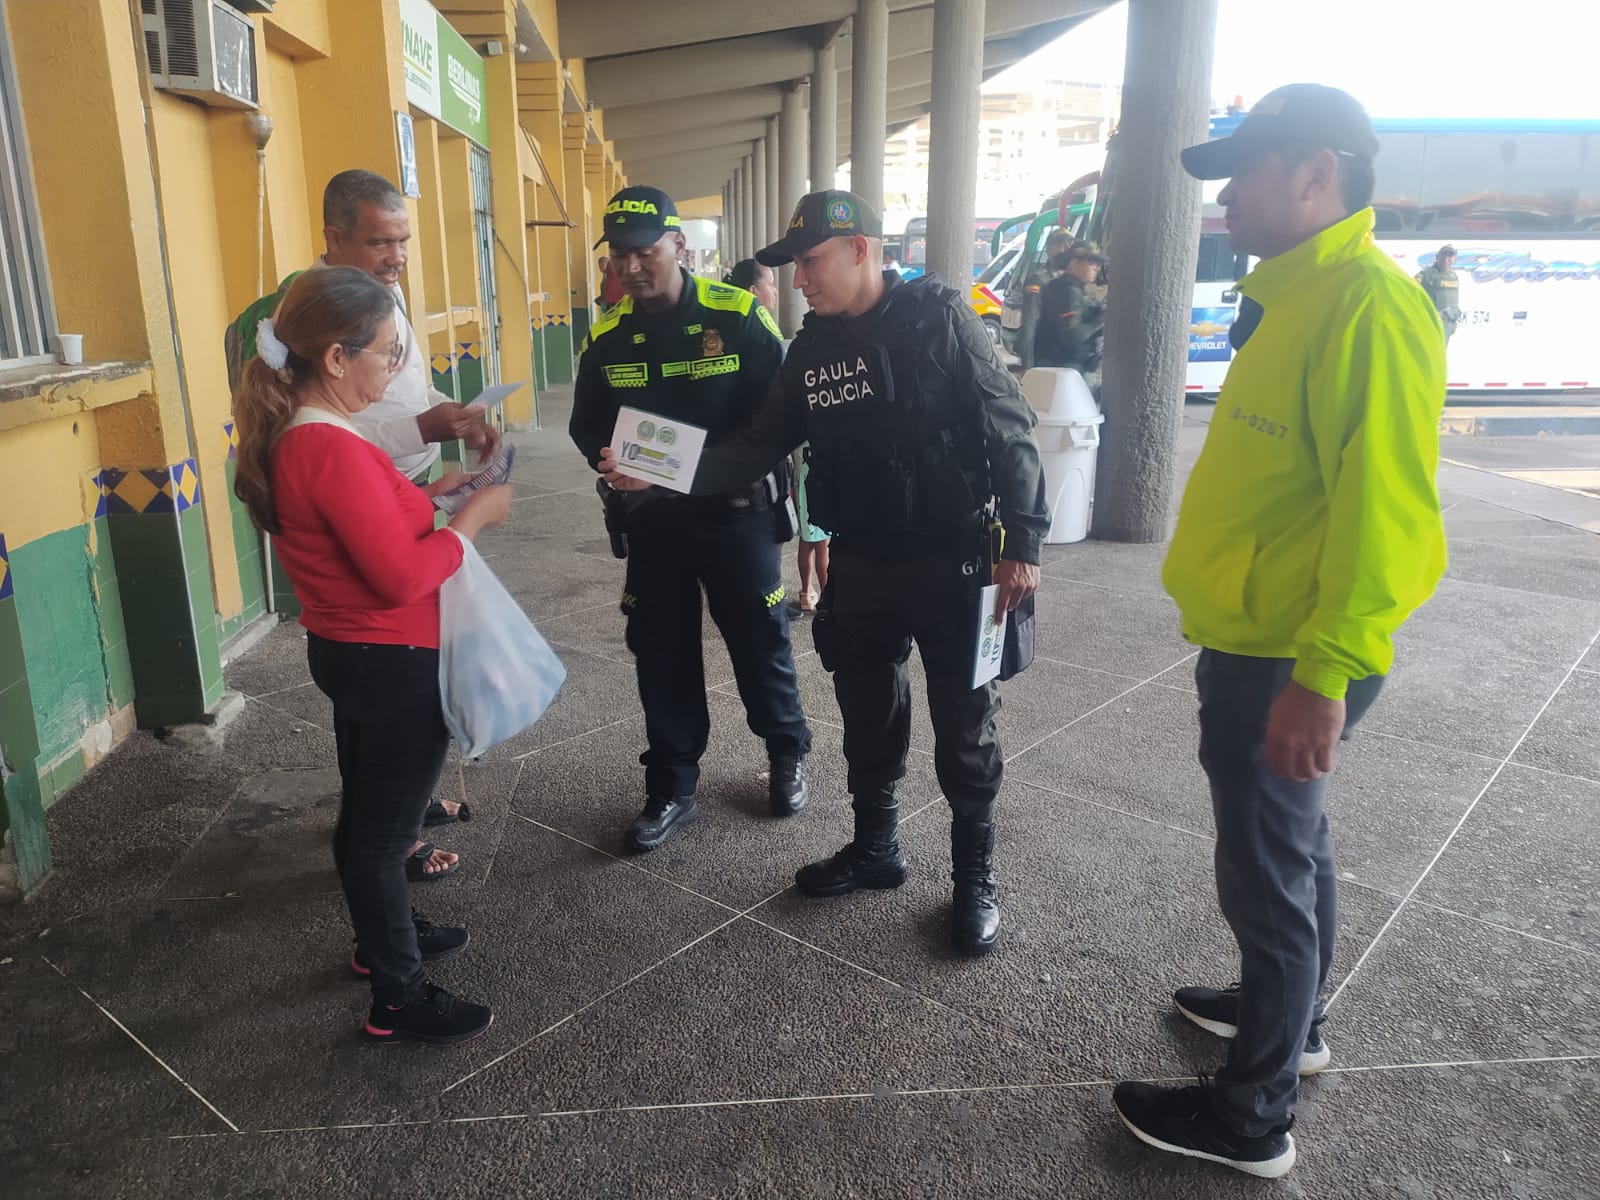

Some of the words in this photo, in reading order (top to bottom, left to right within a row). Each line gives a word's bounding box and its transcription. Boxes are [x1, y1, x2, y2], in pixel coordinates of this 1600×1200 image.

[447, 53, 481, 101] BERLINAS
[605, 199, 659, 215] OLICÍA
[1472, 310, 1490, 325] 574
[804, 356, 868, 388] GAULA
[807, 380, 875, 411] POLICIA
